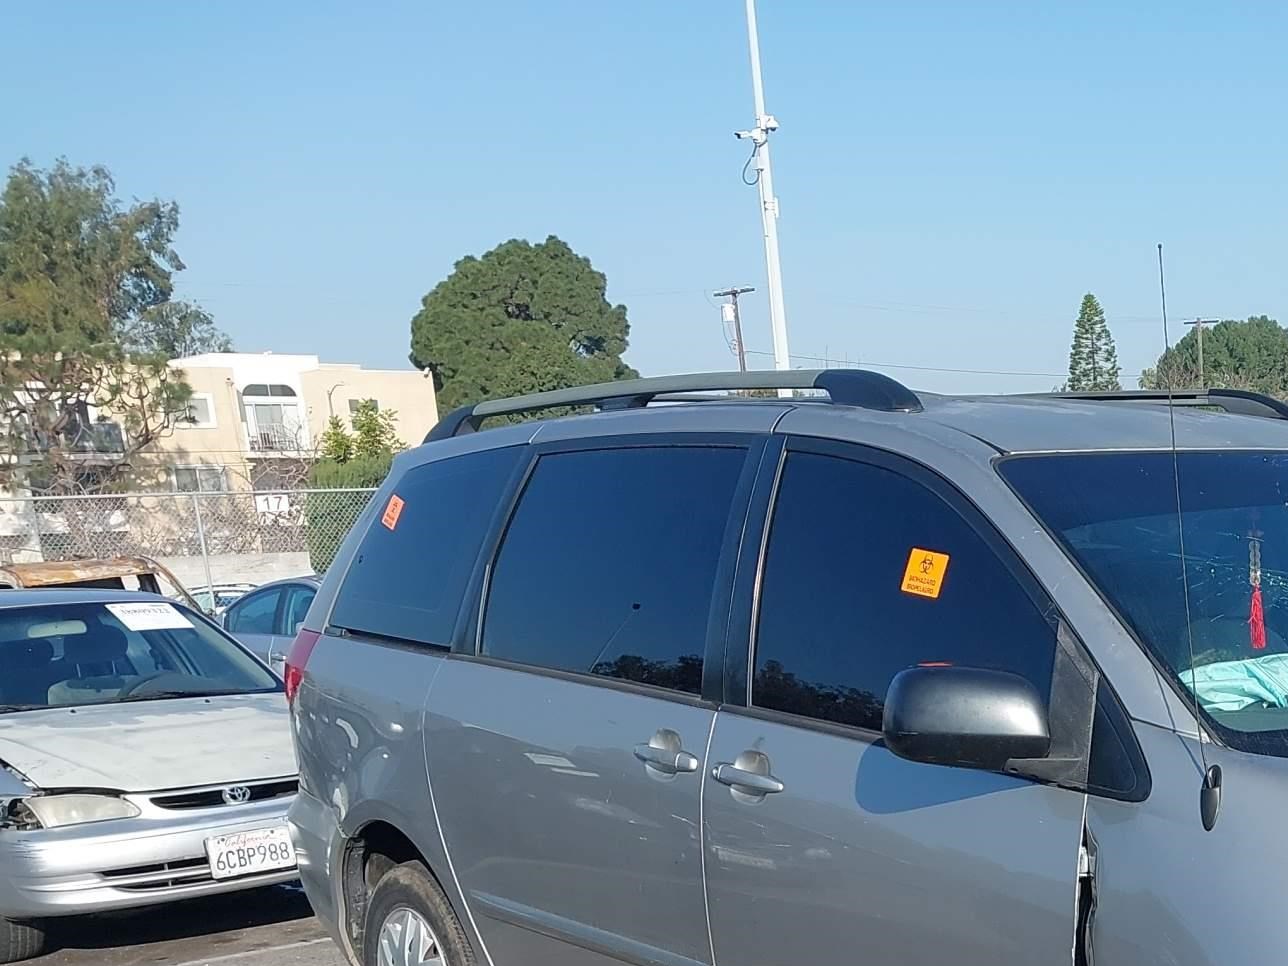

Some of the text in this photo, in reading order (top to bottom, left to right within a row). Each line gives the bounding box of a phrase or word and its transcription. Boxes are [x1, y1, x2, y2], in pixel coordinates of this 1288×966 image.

[263, 496, 282, 510] 17
[224, 833, 270, 848] California
[217, 842, 290, 870] 6CBP988
